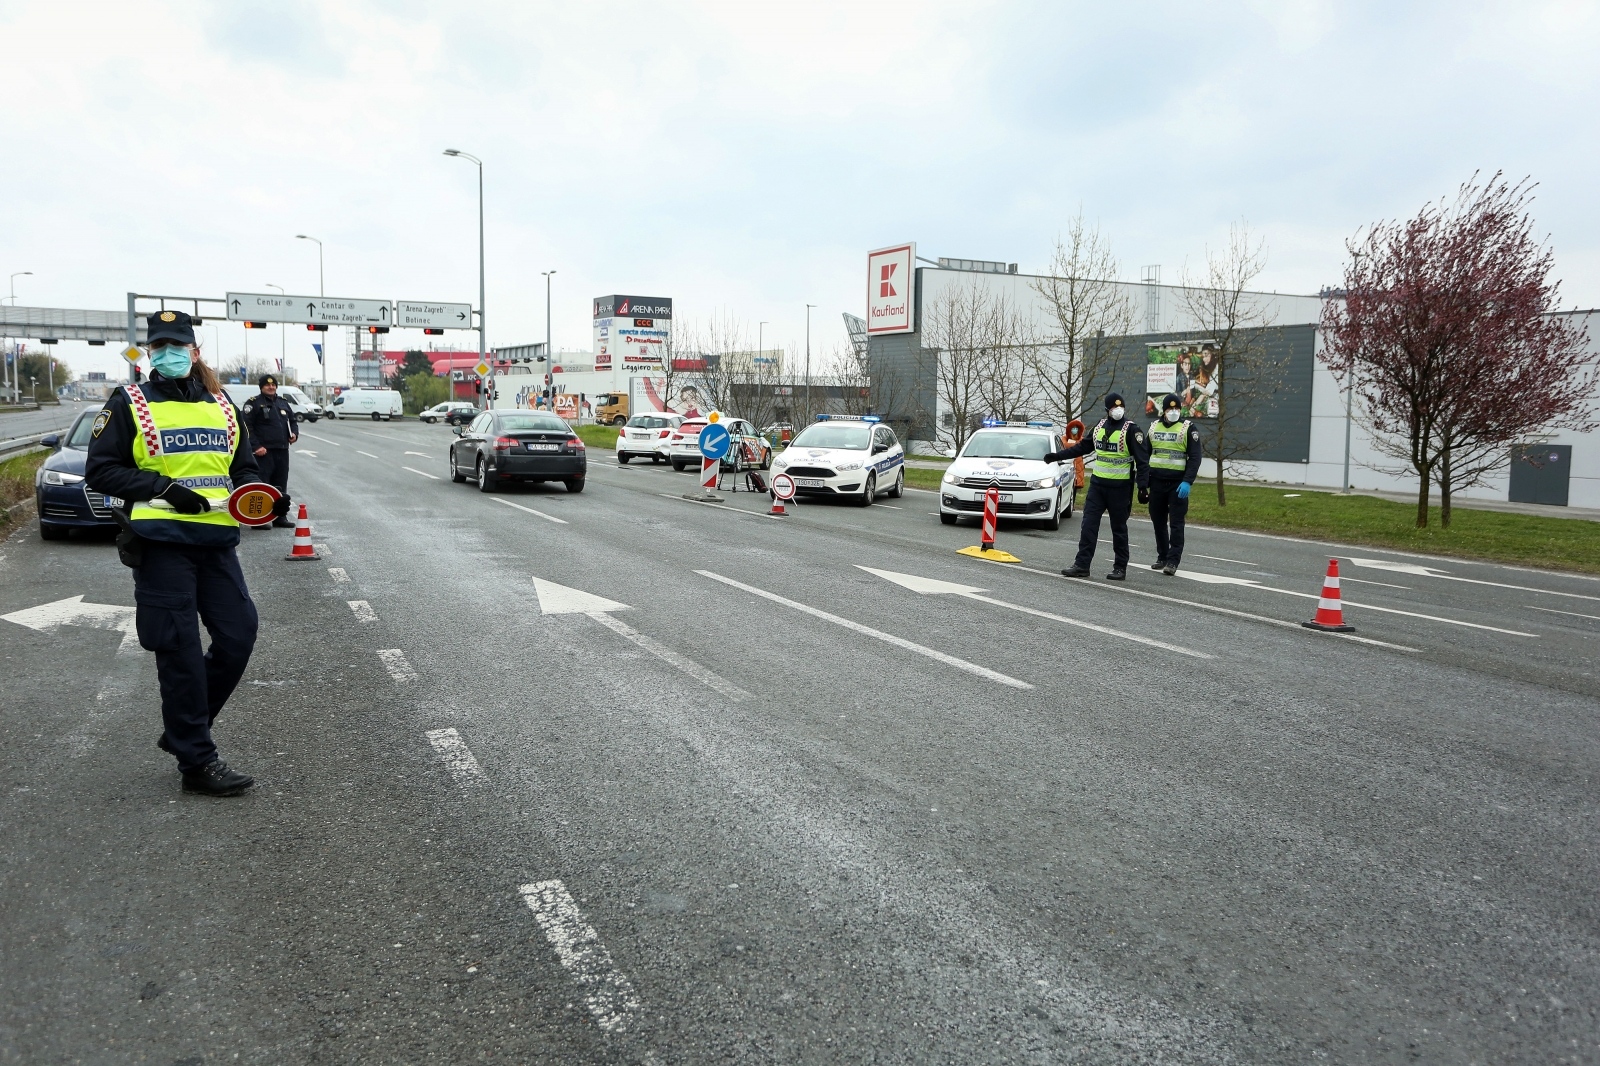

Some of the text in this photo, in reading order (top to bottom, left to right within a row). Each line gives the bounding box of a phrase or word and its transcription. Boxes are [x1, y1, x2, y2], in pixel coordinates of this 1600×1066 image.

[256, 298, 281, 306] Centar
[321, 301, 345, 309] Centar
[630, 305, 671, 315] ARENA PARK
[871, 303, 905, 317] Kaufland
[405, 316, 431, 324] Botinec
[640, 329, 669, 337] domenica
[379, 355, 397, 365] Star
[621, 363, 651, 373] Leggiero
[557, 396, 575, 407] DA
[164, 433, 227, 448] POLICIJA
[111, 495, 123, 507] ZG
